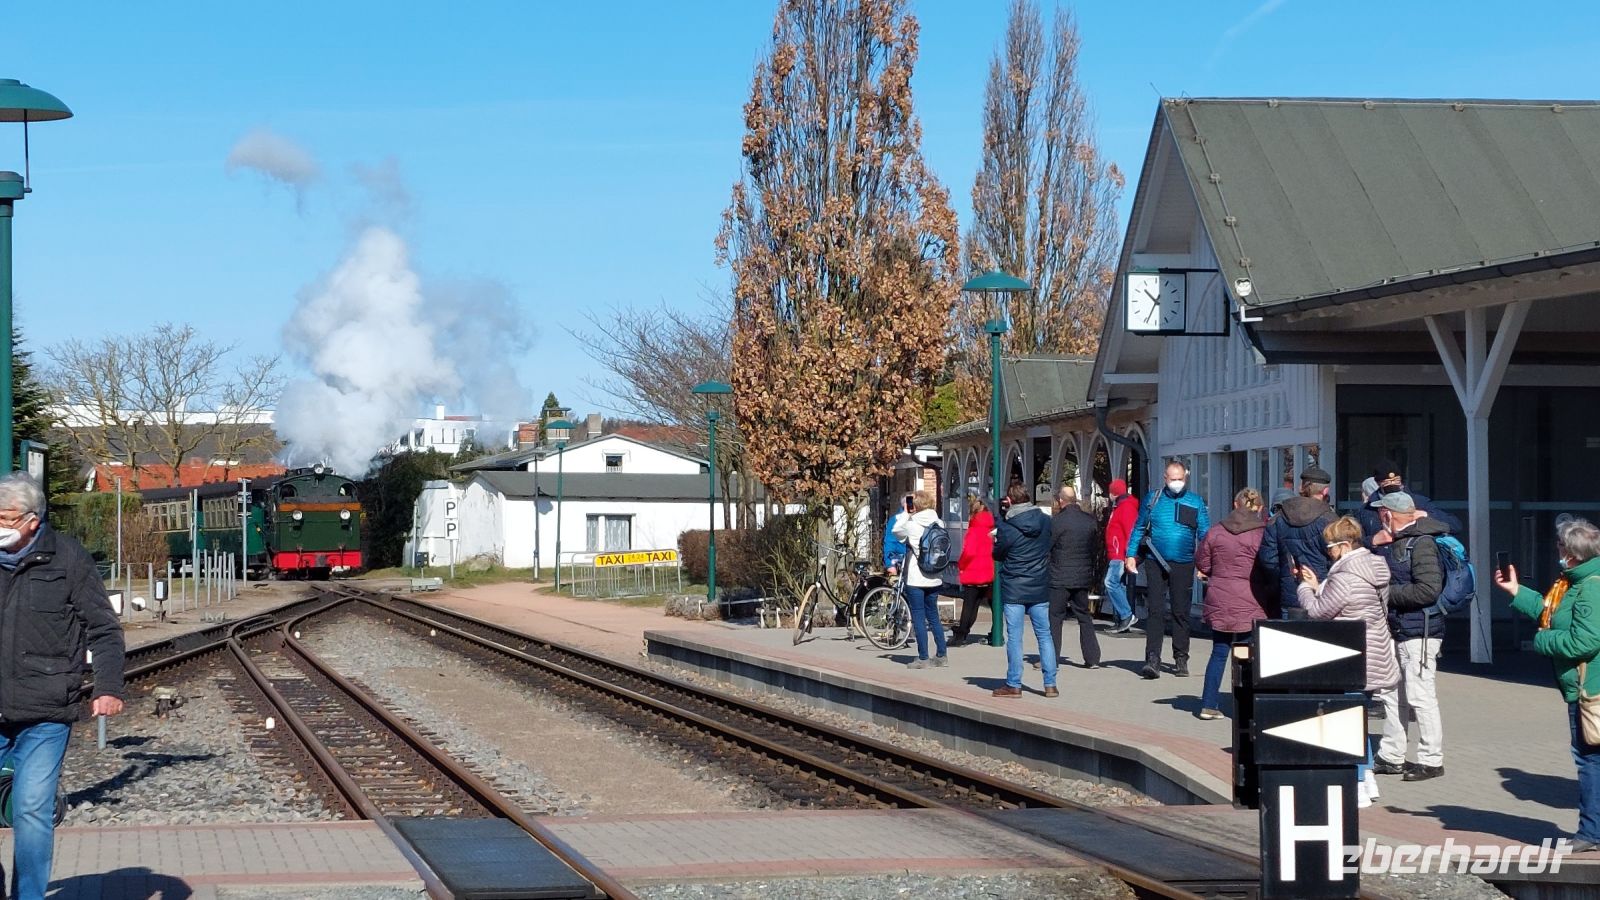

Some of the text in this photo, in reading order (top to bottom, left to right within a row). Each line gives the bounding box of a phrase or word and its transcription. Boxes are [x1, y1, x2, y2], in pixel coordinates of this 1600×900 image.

[446, 501, 456, 516] P
[447, 522, 457, 537] P
[598, 554, 625, 565] TAXI
[646, 551, 672, 562] TAXI
[1279, 785, 1344, 881] H
